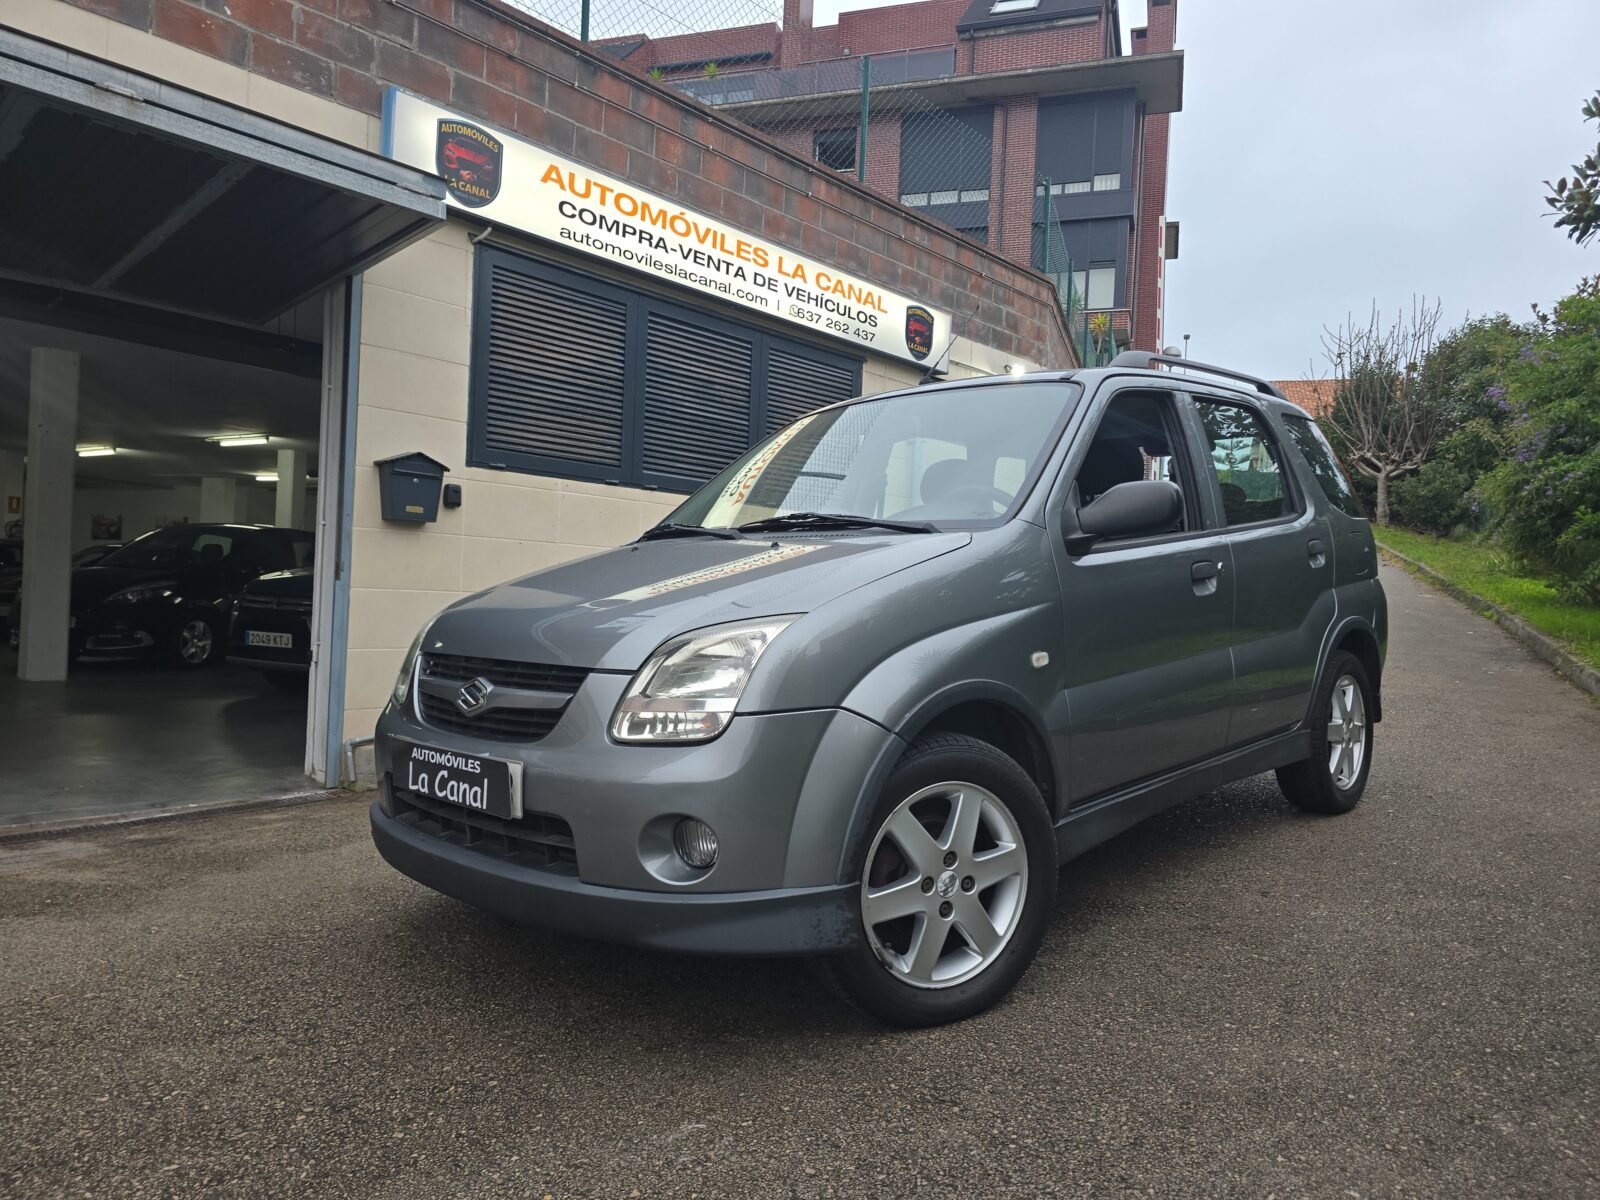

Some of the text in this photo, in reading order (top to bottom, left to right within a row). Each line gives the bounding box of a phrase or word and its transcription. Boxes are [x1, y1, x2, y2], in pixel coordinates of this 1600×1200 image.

[441, 123, 499, 153] AUTOMÓVILES
[458, 181, 491, 199] CANAL
[540, 163, 888, 314] AUTOMÓVILES LA CANAL
[558, 200, 878, 328] COMPRA-VENTA DE VEHÍCULOS
[560, 227, 876, 342] automovileslacanal.com 637 262 437
[250, 633, 290, 647] 2049 KTJ
[411, 747, 481, 774] AUTOMÓVILES
[408, 761, 488, 810] La Canal
